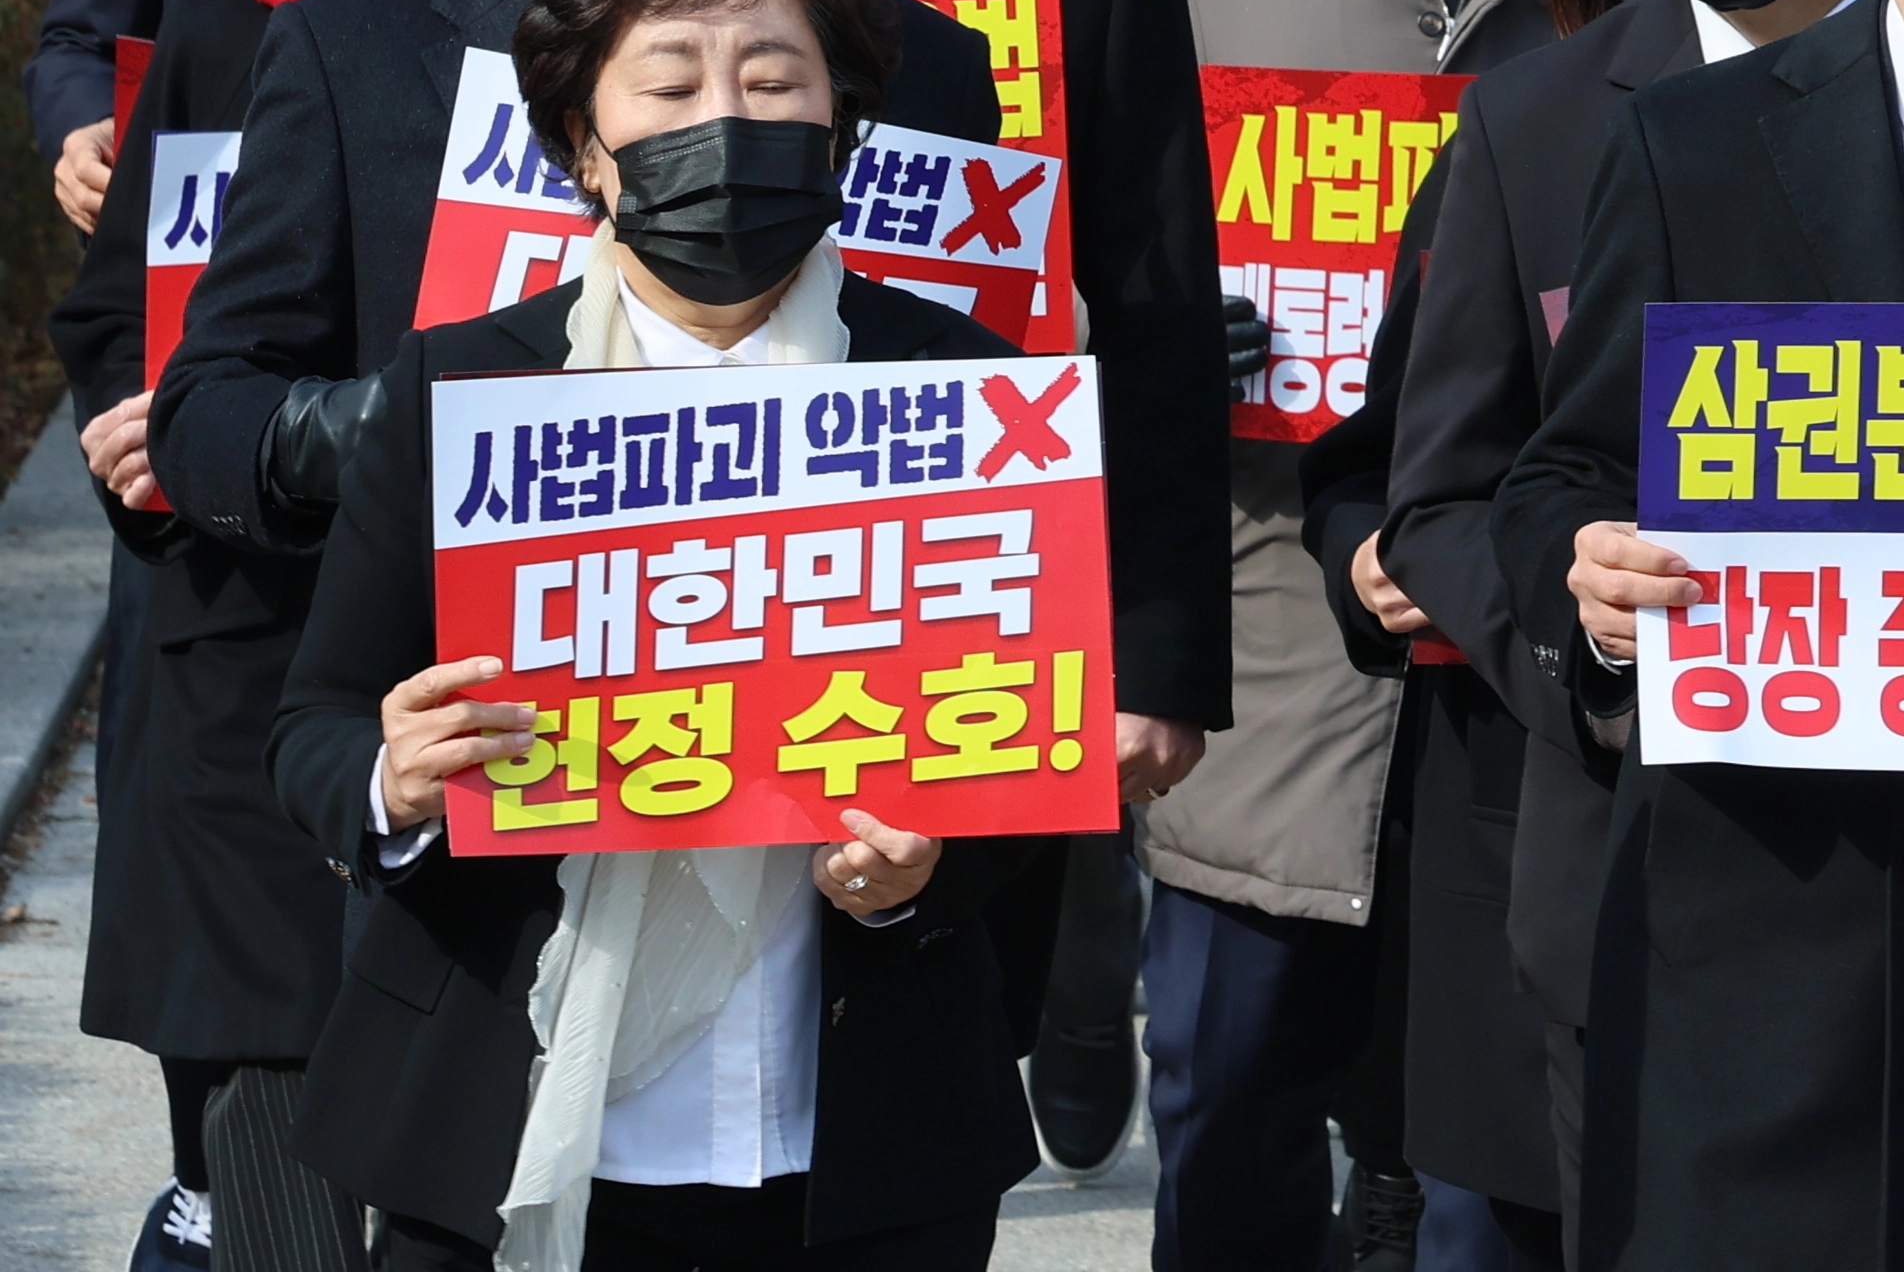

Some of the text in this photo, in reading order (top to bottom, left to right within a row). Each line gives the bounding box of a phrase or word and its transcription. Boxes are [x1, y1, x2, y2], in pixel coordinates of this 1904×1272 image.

[454, 380, 965, 528] 사법파괴 악법
[511, 508, 1040, 679] 대한민국
[1666, 564, 1848, 738] 당장
[482, 650, 1085, 832] 헌정 수호!
